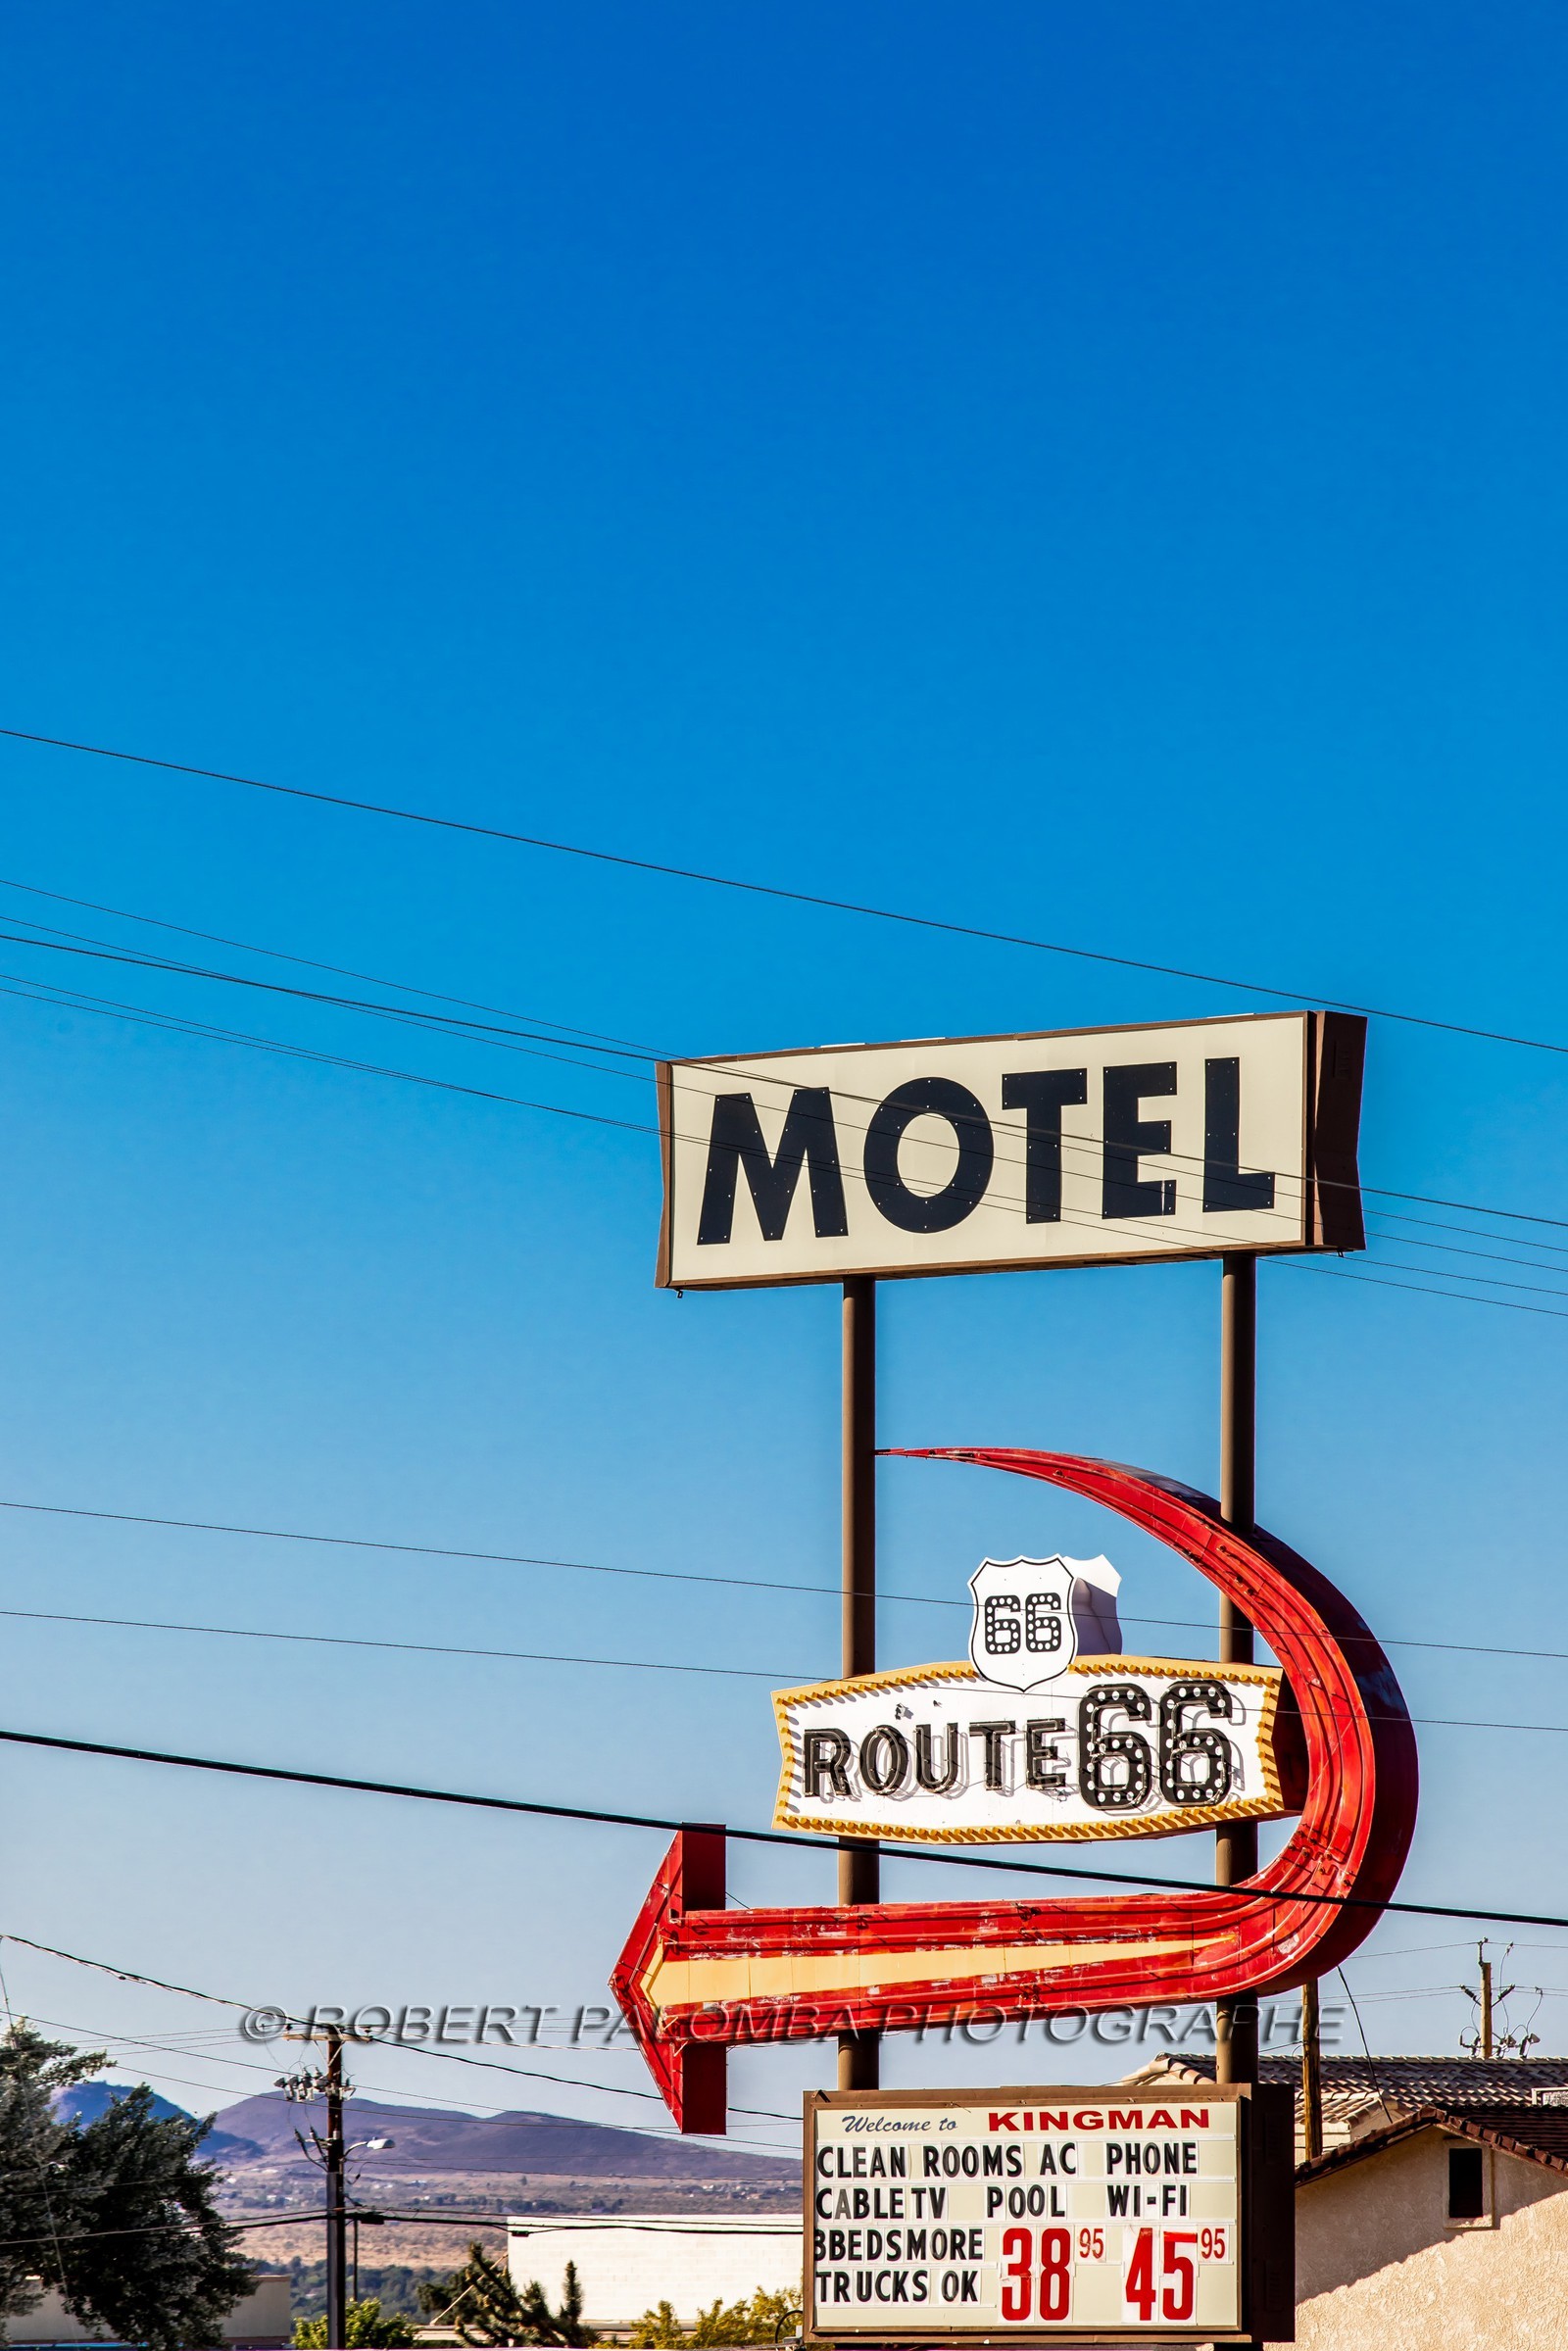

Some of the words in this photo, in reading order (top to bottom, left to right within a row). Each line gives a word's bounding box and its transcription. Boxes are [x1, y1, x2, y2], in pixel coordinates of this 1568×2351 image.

[697, 1056, 1275, 1246] MOTEL
[984, 1592, 1062, 1655] 66
[803, 1719, 1066, 1797] ROUTE
[1078, 1679, 1234, 1810] 66
[842, 2115, 932, 2132] Welcome
[939, 2117, 958, 2132] to
[988, 2108, 1210, 2132] KINGMAN
[817, 2145, 907, 2180] CLEAN
[923, 2142, 1023, 2179] ROOMS
[1039, 2142, 1077, 2175] AC
[1105, 2141, 1198, 2175] PHONE
[986, 2183, 1065, 2219] POOL
[1106, 2183, 1187, 2218] WI-FI
[1079, 2228, 1104, 2259] 95
[1200, 2228, 1226, 2259] 95
[815, 2269, 929, 2304] TRUCKS
[940, 2268, 979, 2302] OK
